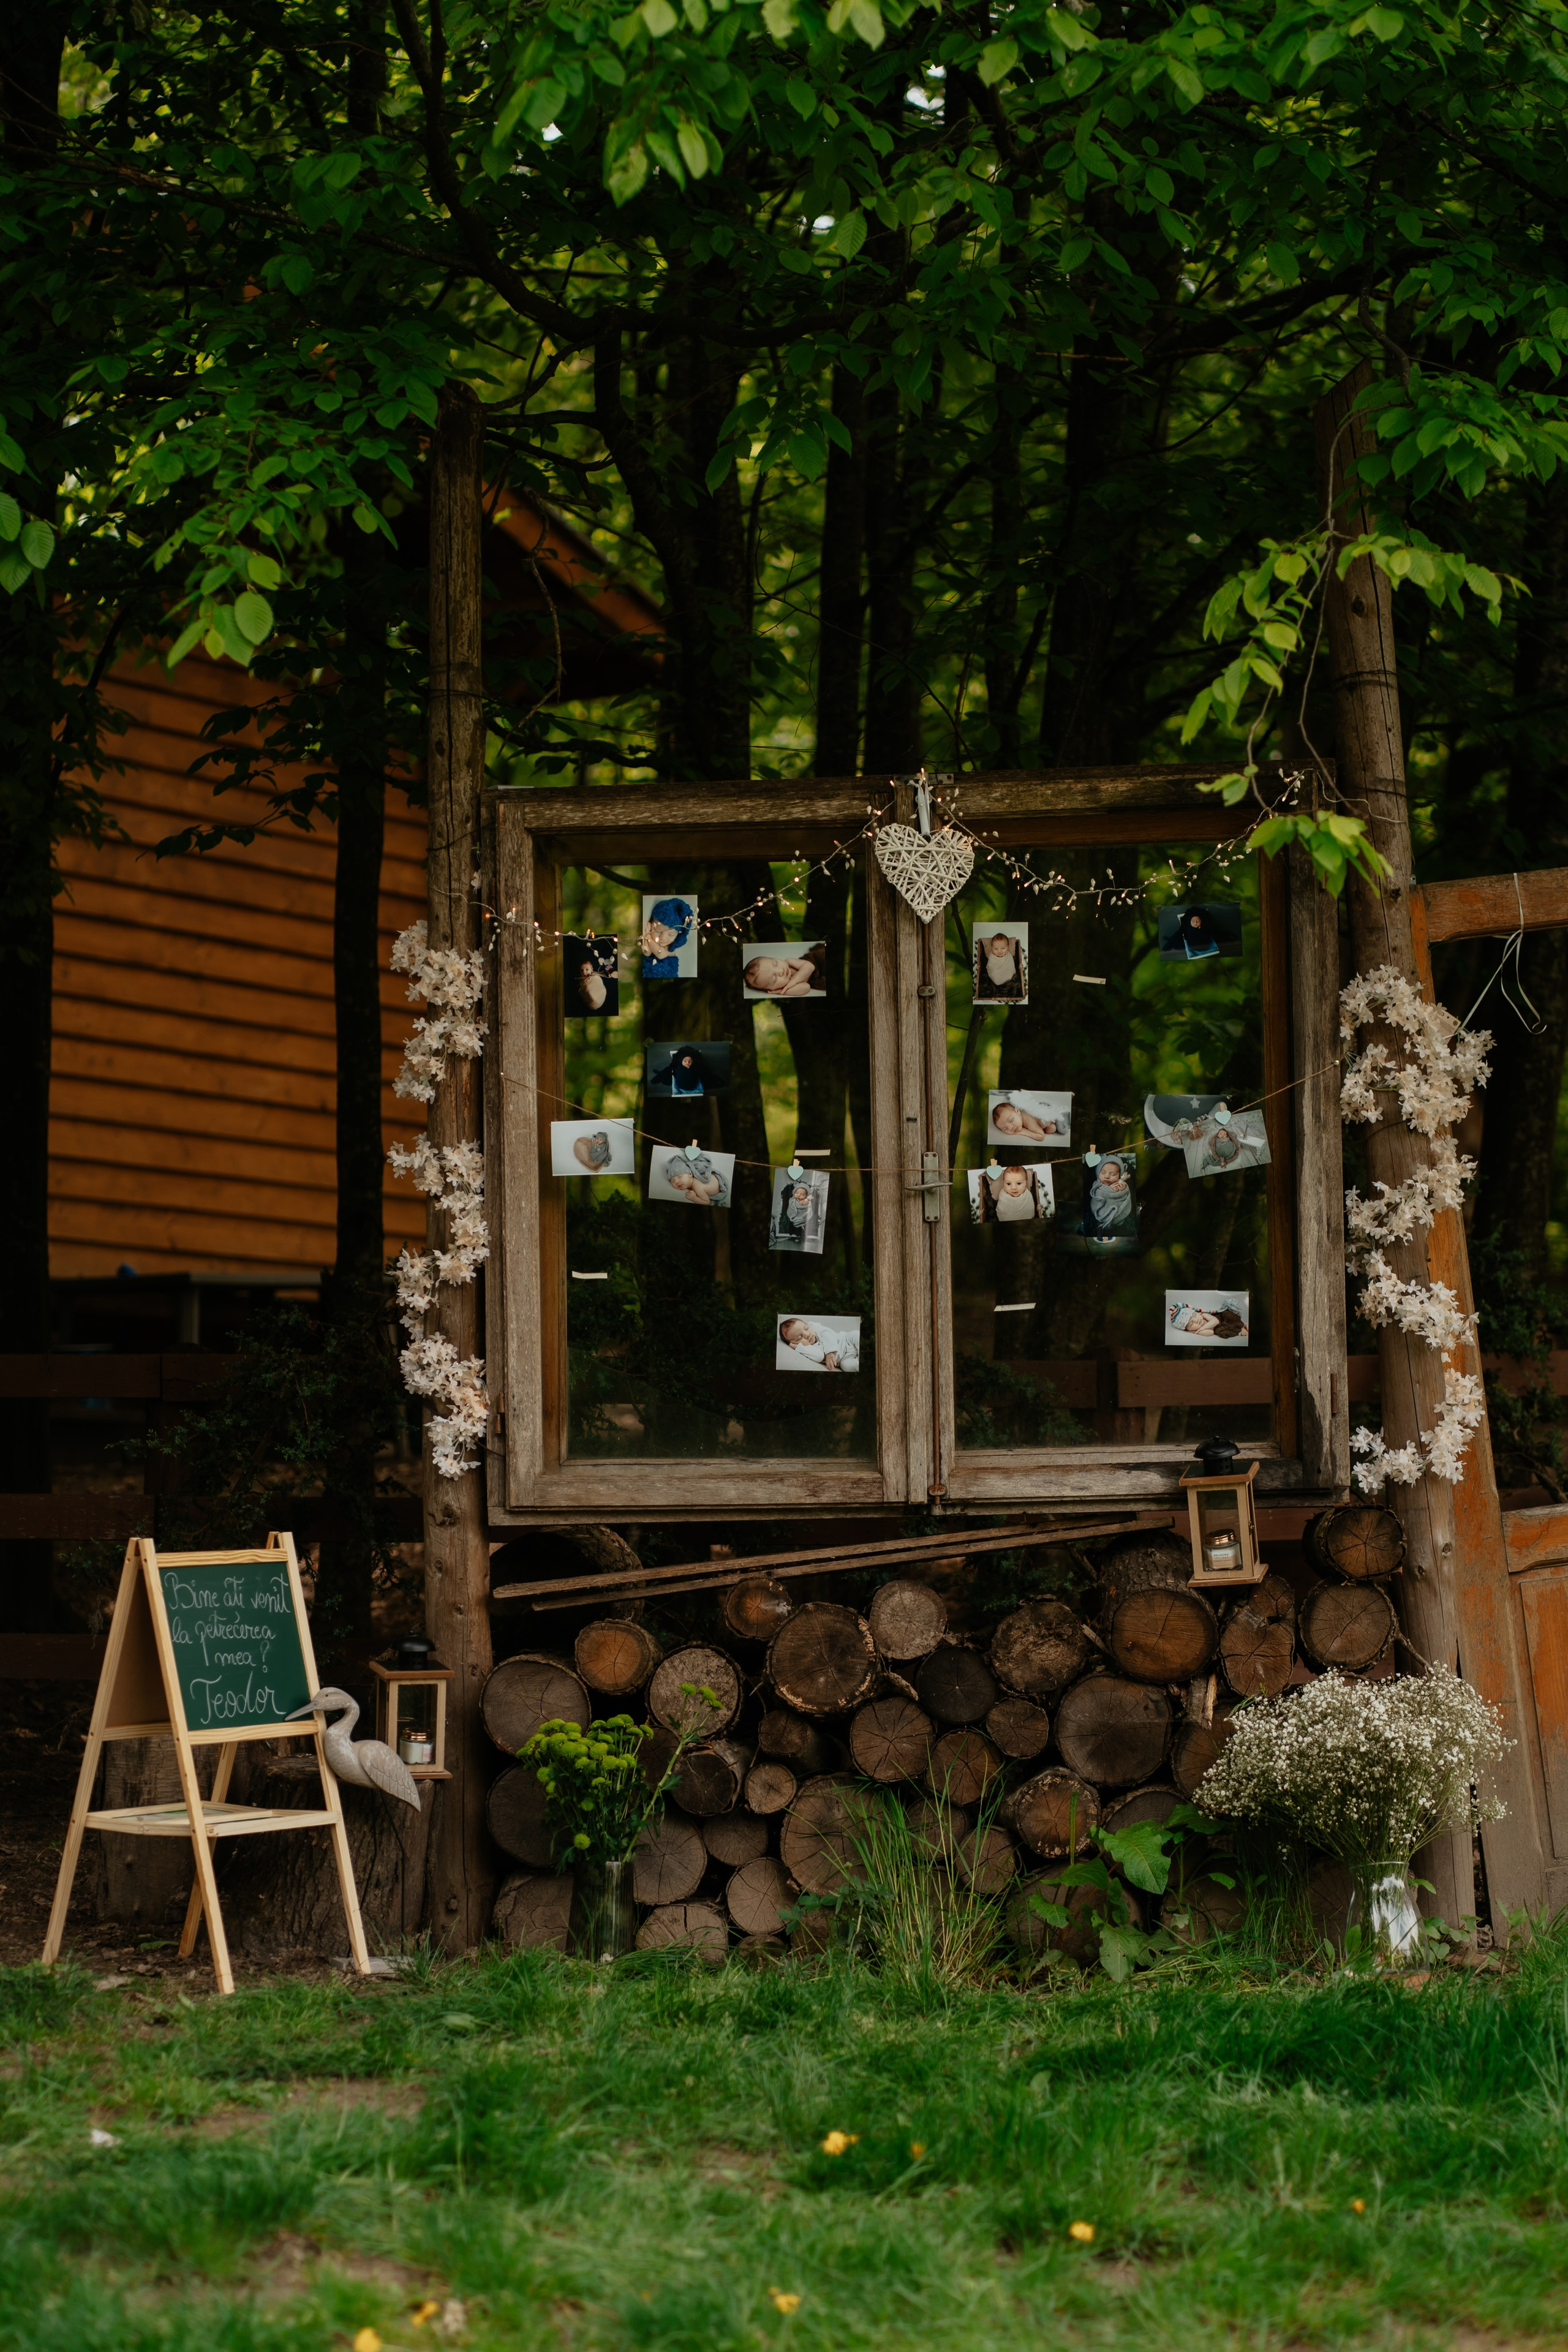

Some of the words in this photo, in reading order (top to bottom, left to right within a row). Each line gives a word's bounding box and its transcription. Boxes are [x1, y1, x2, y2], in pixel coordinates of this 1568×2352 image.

[165, 1572, 220, 1610] Bine
[251, 1573, 290, 1613] venit
[172, 1616, 193, 1644] la
[190, 1671, 287, 1724] Teodor
